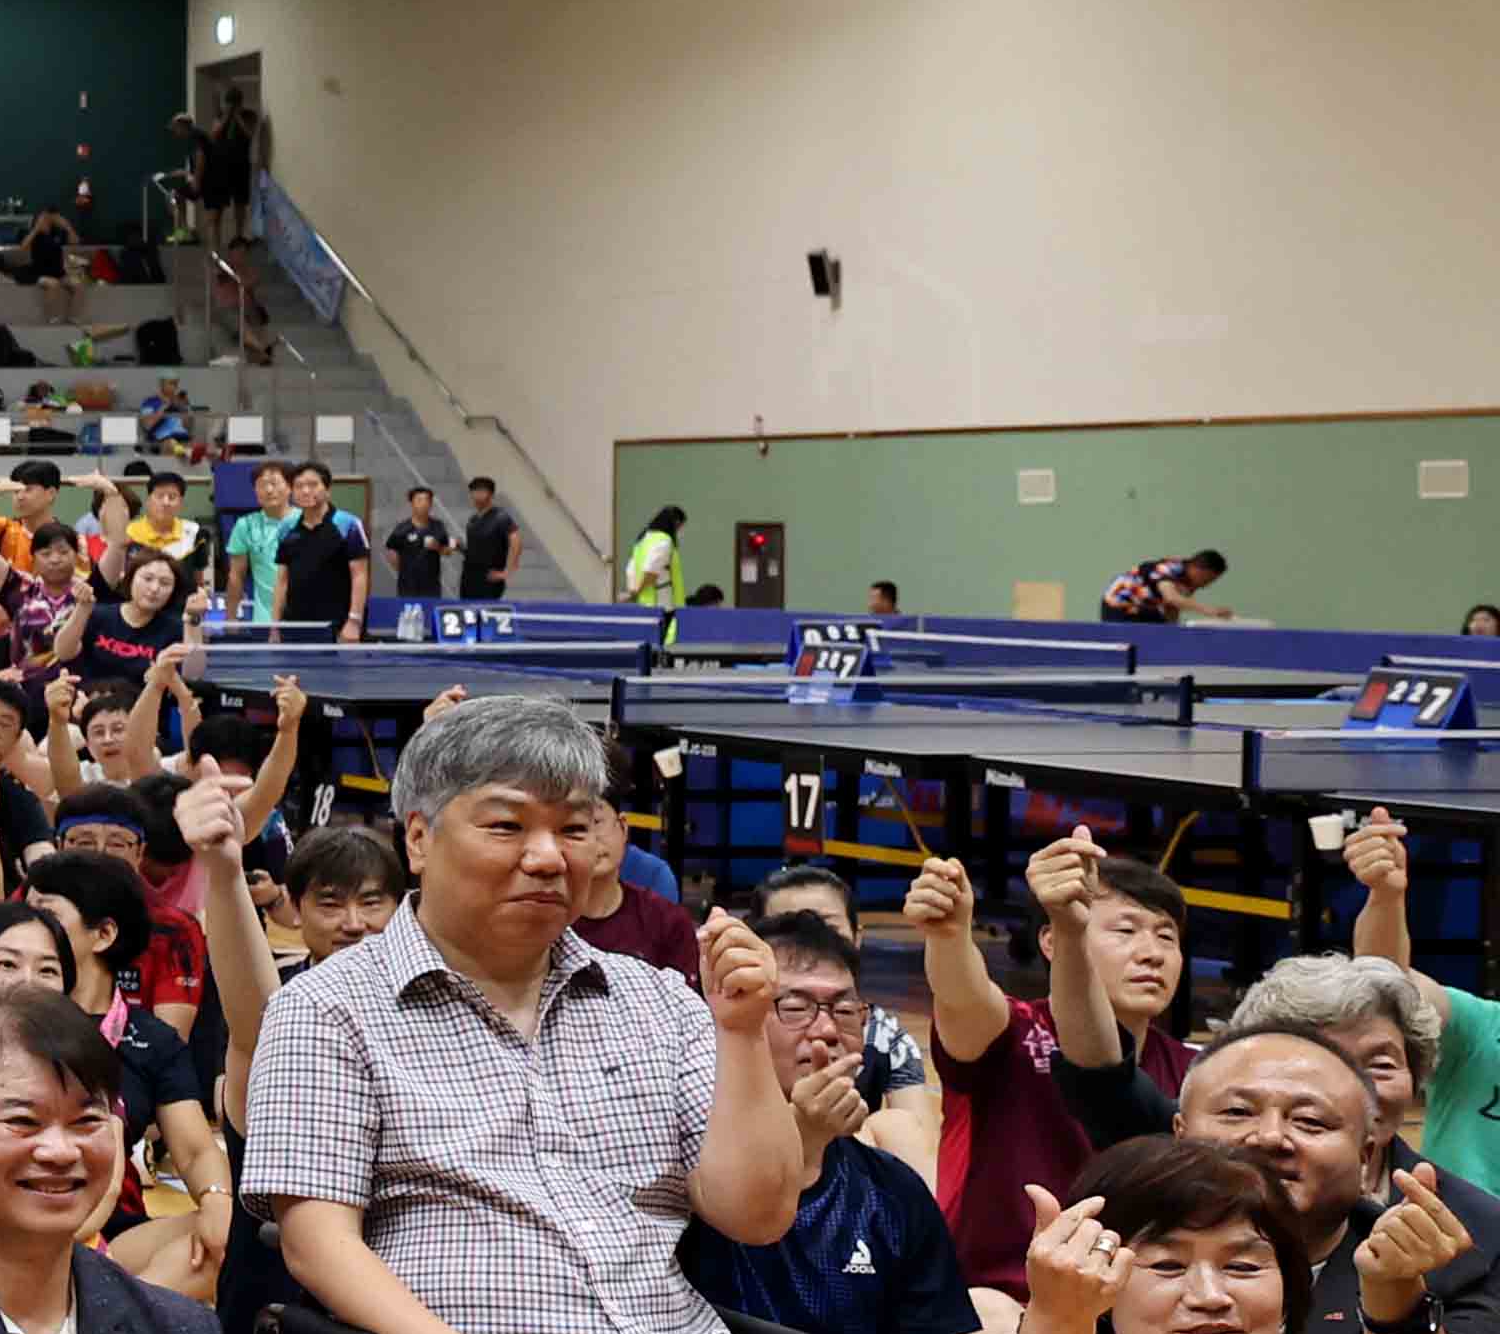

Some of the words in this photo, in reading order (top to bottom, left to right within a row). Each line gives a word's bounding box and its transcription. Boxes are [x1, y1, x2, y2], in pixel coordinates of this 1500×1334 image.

[1387, 679, 1410, 703] 2
[1407, 680, 1429, 704] 2
[1418, 686, 1453, 721] 7
[310, 783, 335, 827] 18
[784, 773, 821, 829] 17
